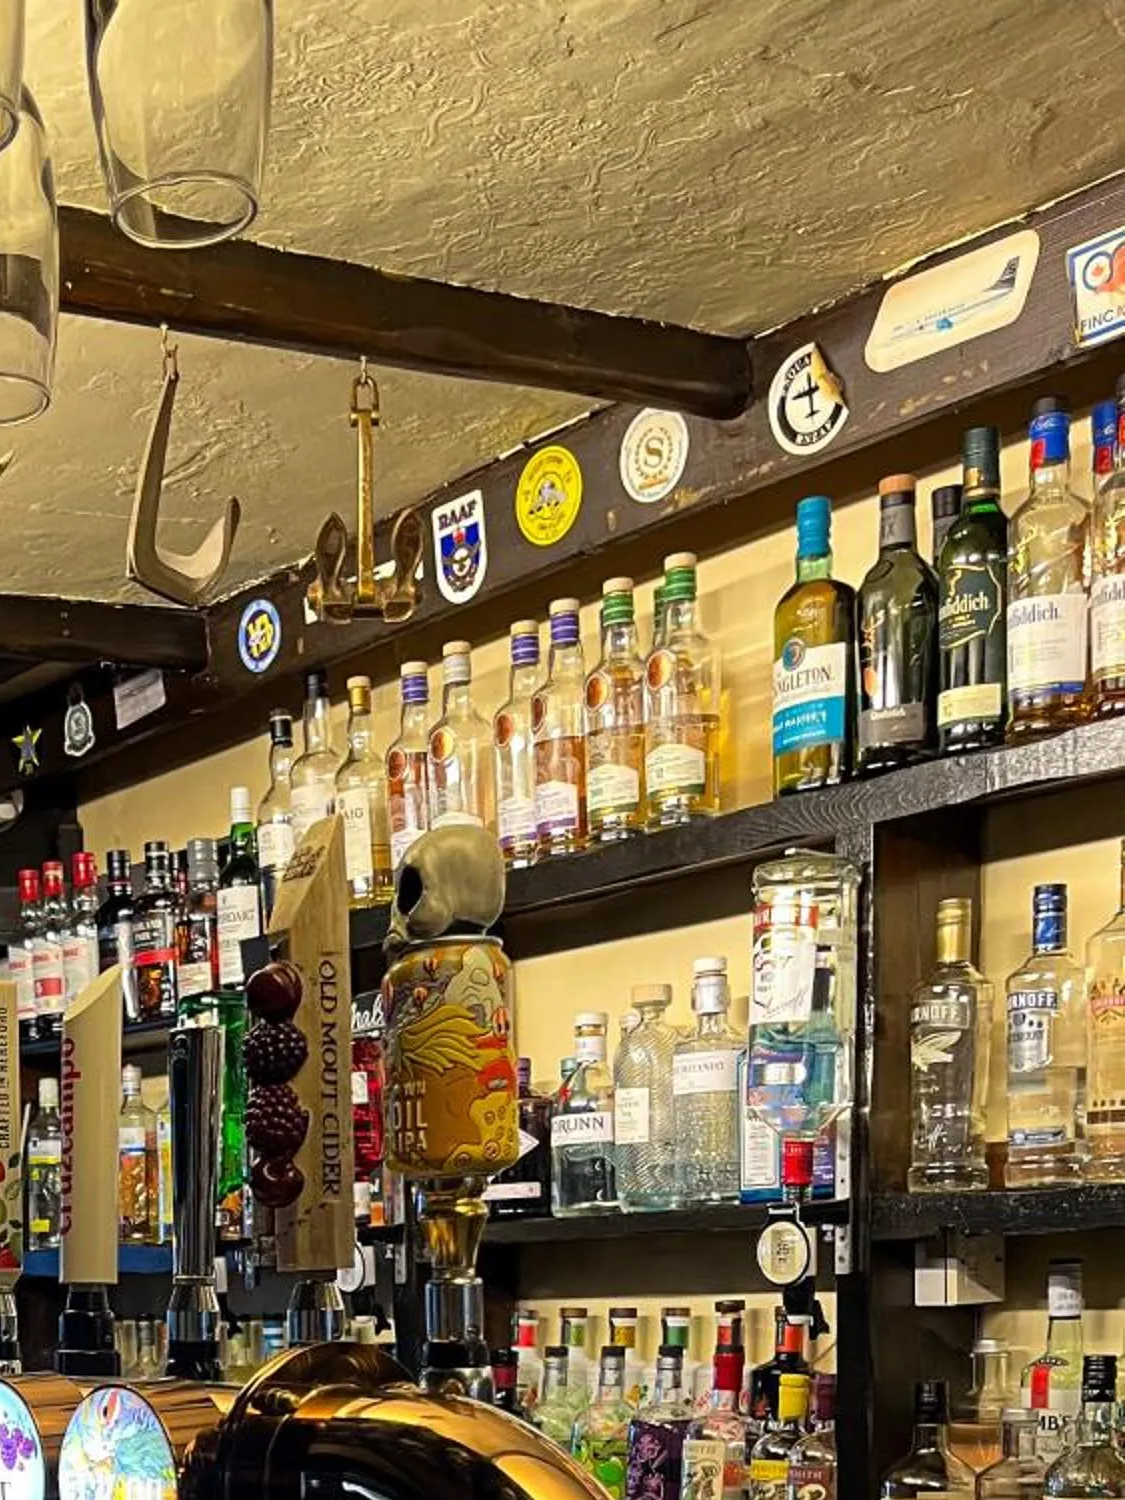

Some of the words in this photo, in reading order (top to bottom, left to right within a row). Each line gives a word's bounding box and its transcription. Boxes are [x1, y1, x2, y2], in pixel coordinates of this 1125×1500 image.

[438, 500, 476, 531] RAAF
[776, 666, 832, 693] NGLETON
[318, 959, 338, 1014] OLD
[320, 1022, 340, 1106] MOUT
[321, 1112, 341, 1195] CIDER
